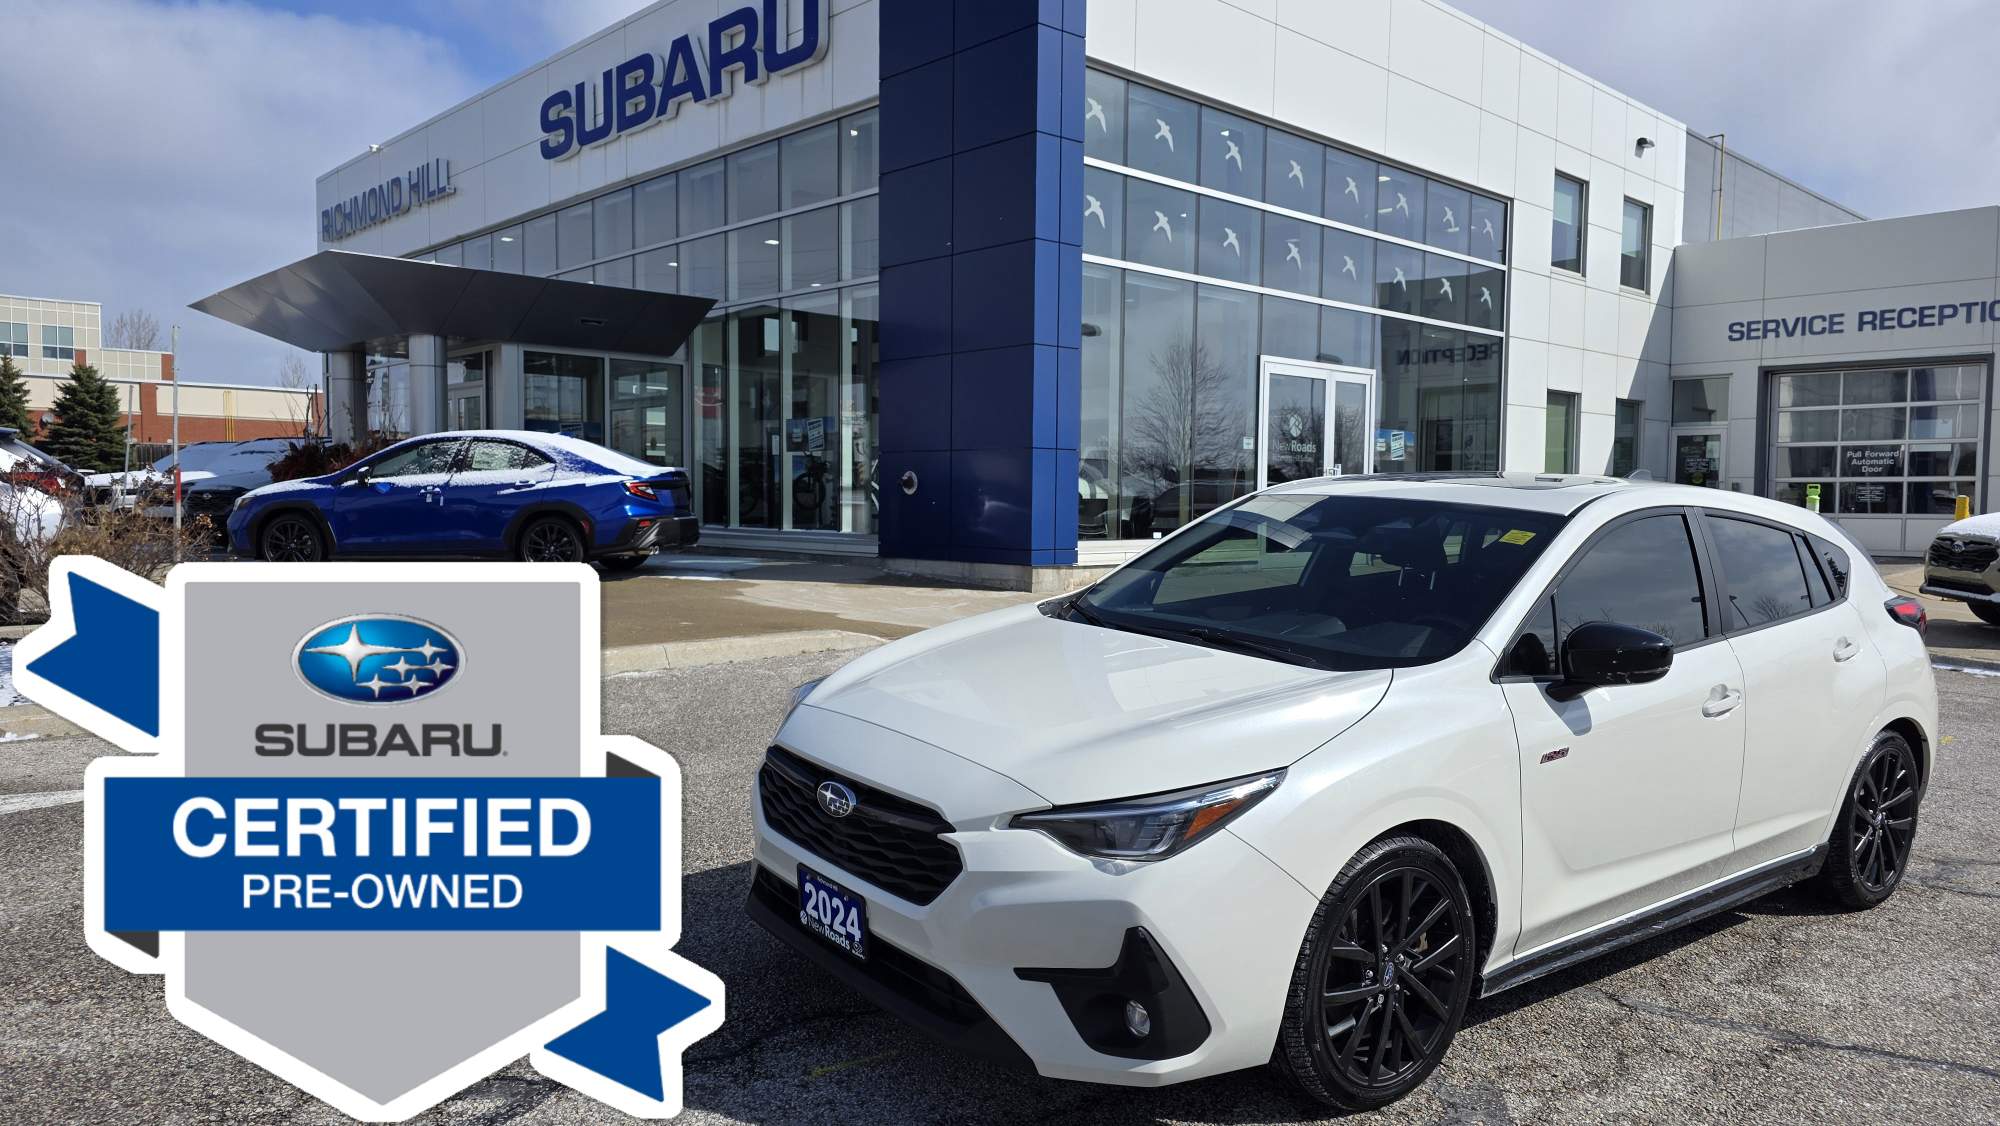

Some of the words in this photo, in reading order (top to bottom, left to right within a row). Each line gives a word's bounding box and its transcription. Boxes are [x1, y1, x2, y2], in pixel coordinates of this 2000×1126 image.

[540, 0, 820, 160] SUBARU
[321, 176, 402, 242] RICHMOND
[408, 158, 450, 209] HILL
[1727, 313, 1845, 341] SERVICE
[1861, 465, 1883, 473] Door
[1864, 450, 1900, 458] Forward
[804, 881, 862, 942] 2024
[808, 915, 851, 950] NewRoads
